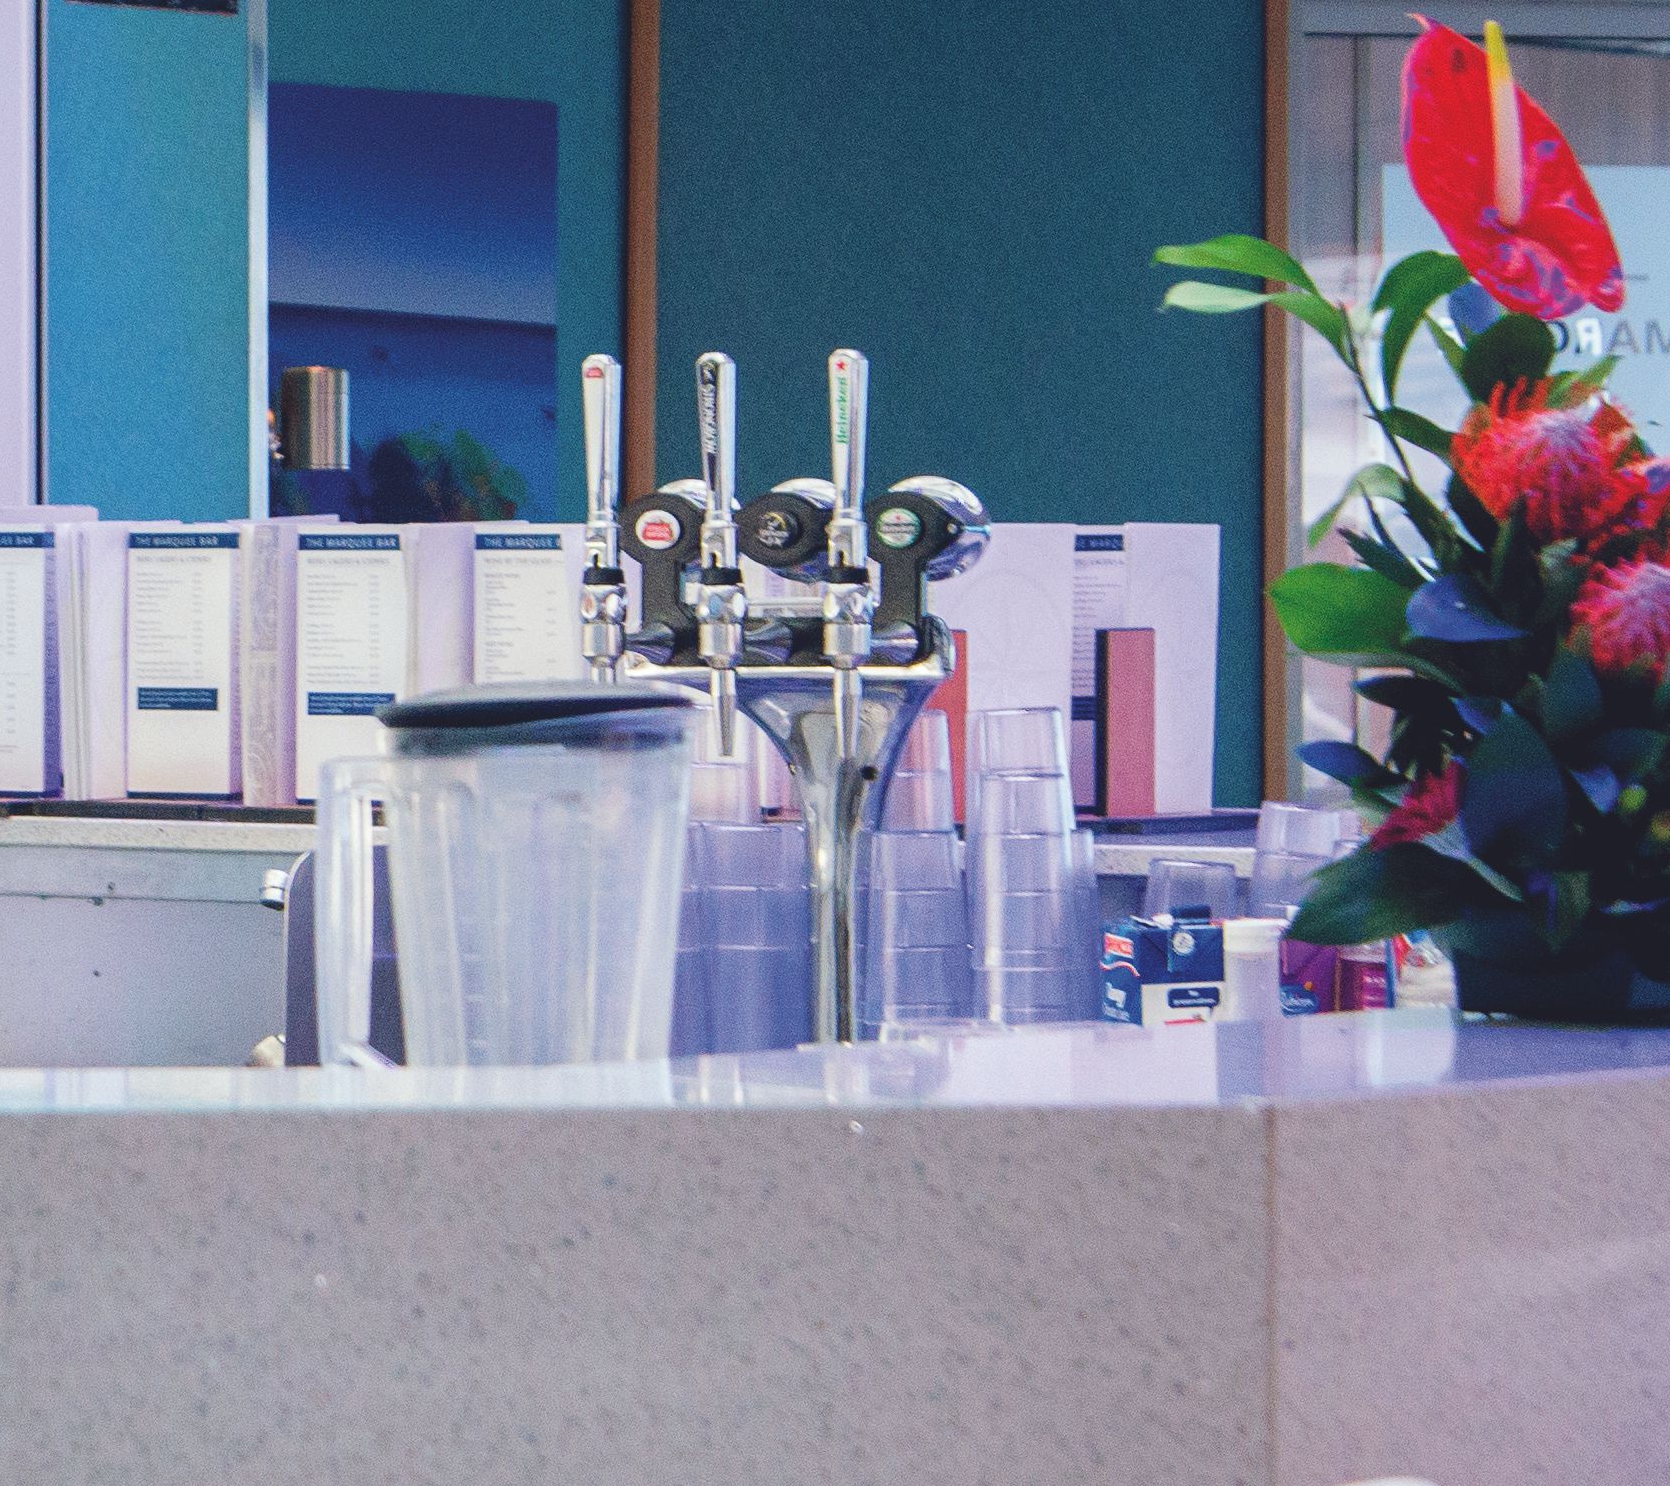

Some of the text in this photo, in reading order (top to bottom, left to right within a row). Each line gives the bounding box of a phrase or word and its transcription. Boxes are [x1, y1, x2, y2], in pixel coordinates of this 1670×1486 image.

[16, 536, 35, 545] BAR
[136, 537, 218, 546] THE MARQUEE BAR
[306, 538, 397, 548] THE MARQUEE BAR
[484, 538, 502, 546] THE
[504, 538, 553, 548] MARQUEE
